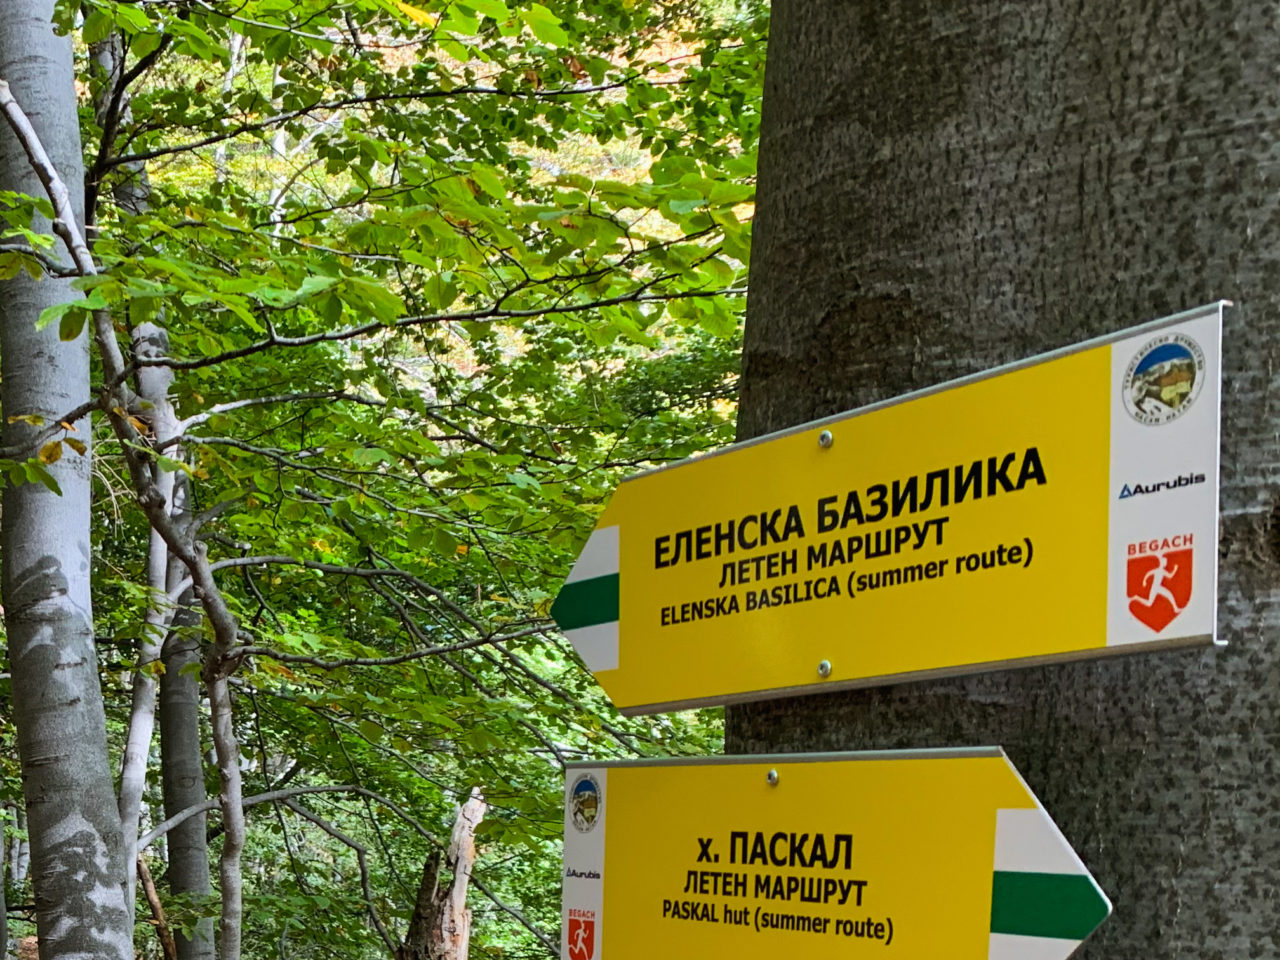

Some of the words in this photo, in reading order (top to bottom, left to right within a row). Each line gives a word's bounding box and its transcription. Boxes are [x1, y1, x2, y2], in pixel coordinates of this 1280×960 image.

[1132, 473, 1206, 496] Aurubis
[654, 504, 805, 570] ЕЛЕНСКА
[817, 447, 1047, 534] БАЗИЛИКА
[718, 549, 798, 588] ЛЕТЕН
[807, 517, 950, 571] МАРШРУТ
[1127, 533, 1194, 555] BEGACH
[661, 594, 740, 627] ELENSKA
[745, 576, 841, 612] BASILICA
[847, 557, 949, 598] (summer
[955, 537, 1034, 575] route)
[696, 837, 720, 863] х.
[729, 830, 853, 870] ПАСКАЛ
[571, 869, 601, 880] Aurubis
[683, 870, 748, 898] ЛЕТЕН
[754, 874, 868, 907] МАРШРУТ
[568, 908, 596, 920] BEGACH
[662, 899, 719, 923] PASKAL
[723, 904, 750, 926] hut
[754, 906, 831, 934] (summer
[835, 917, 894, 946] route)
